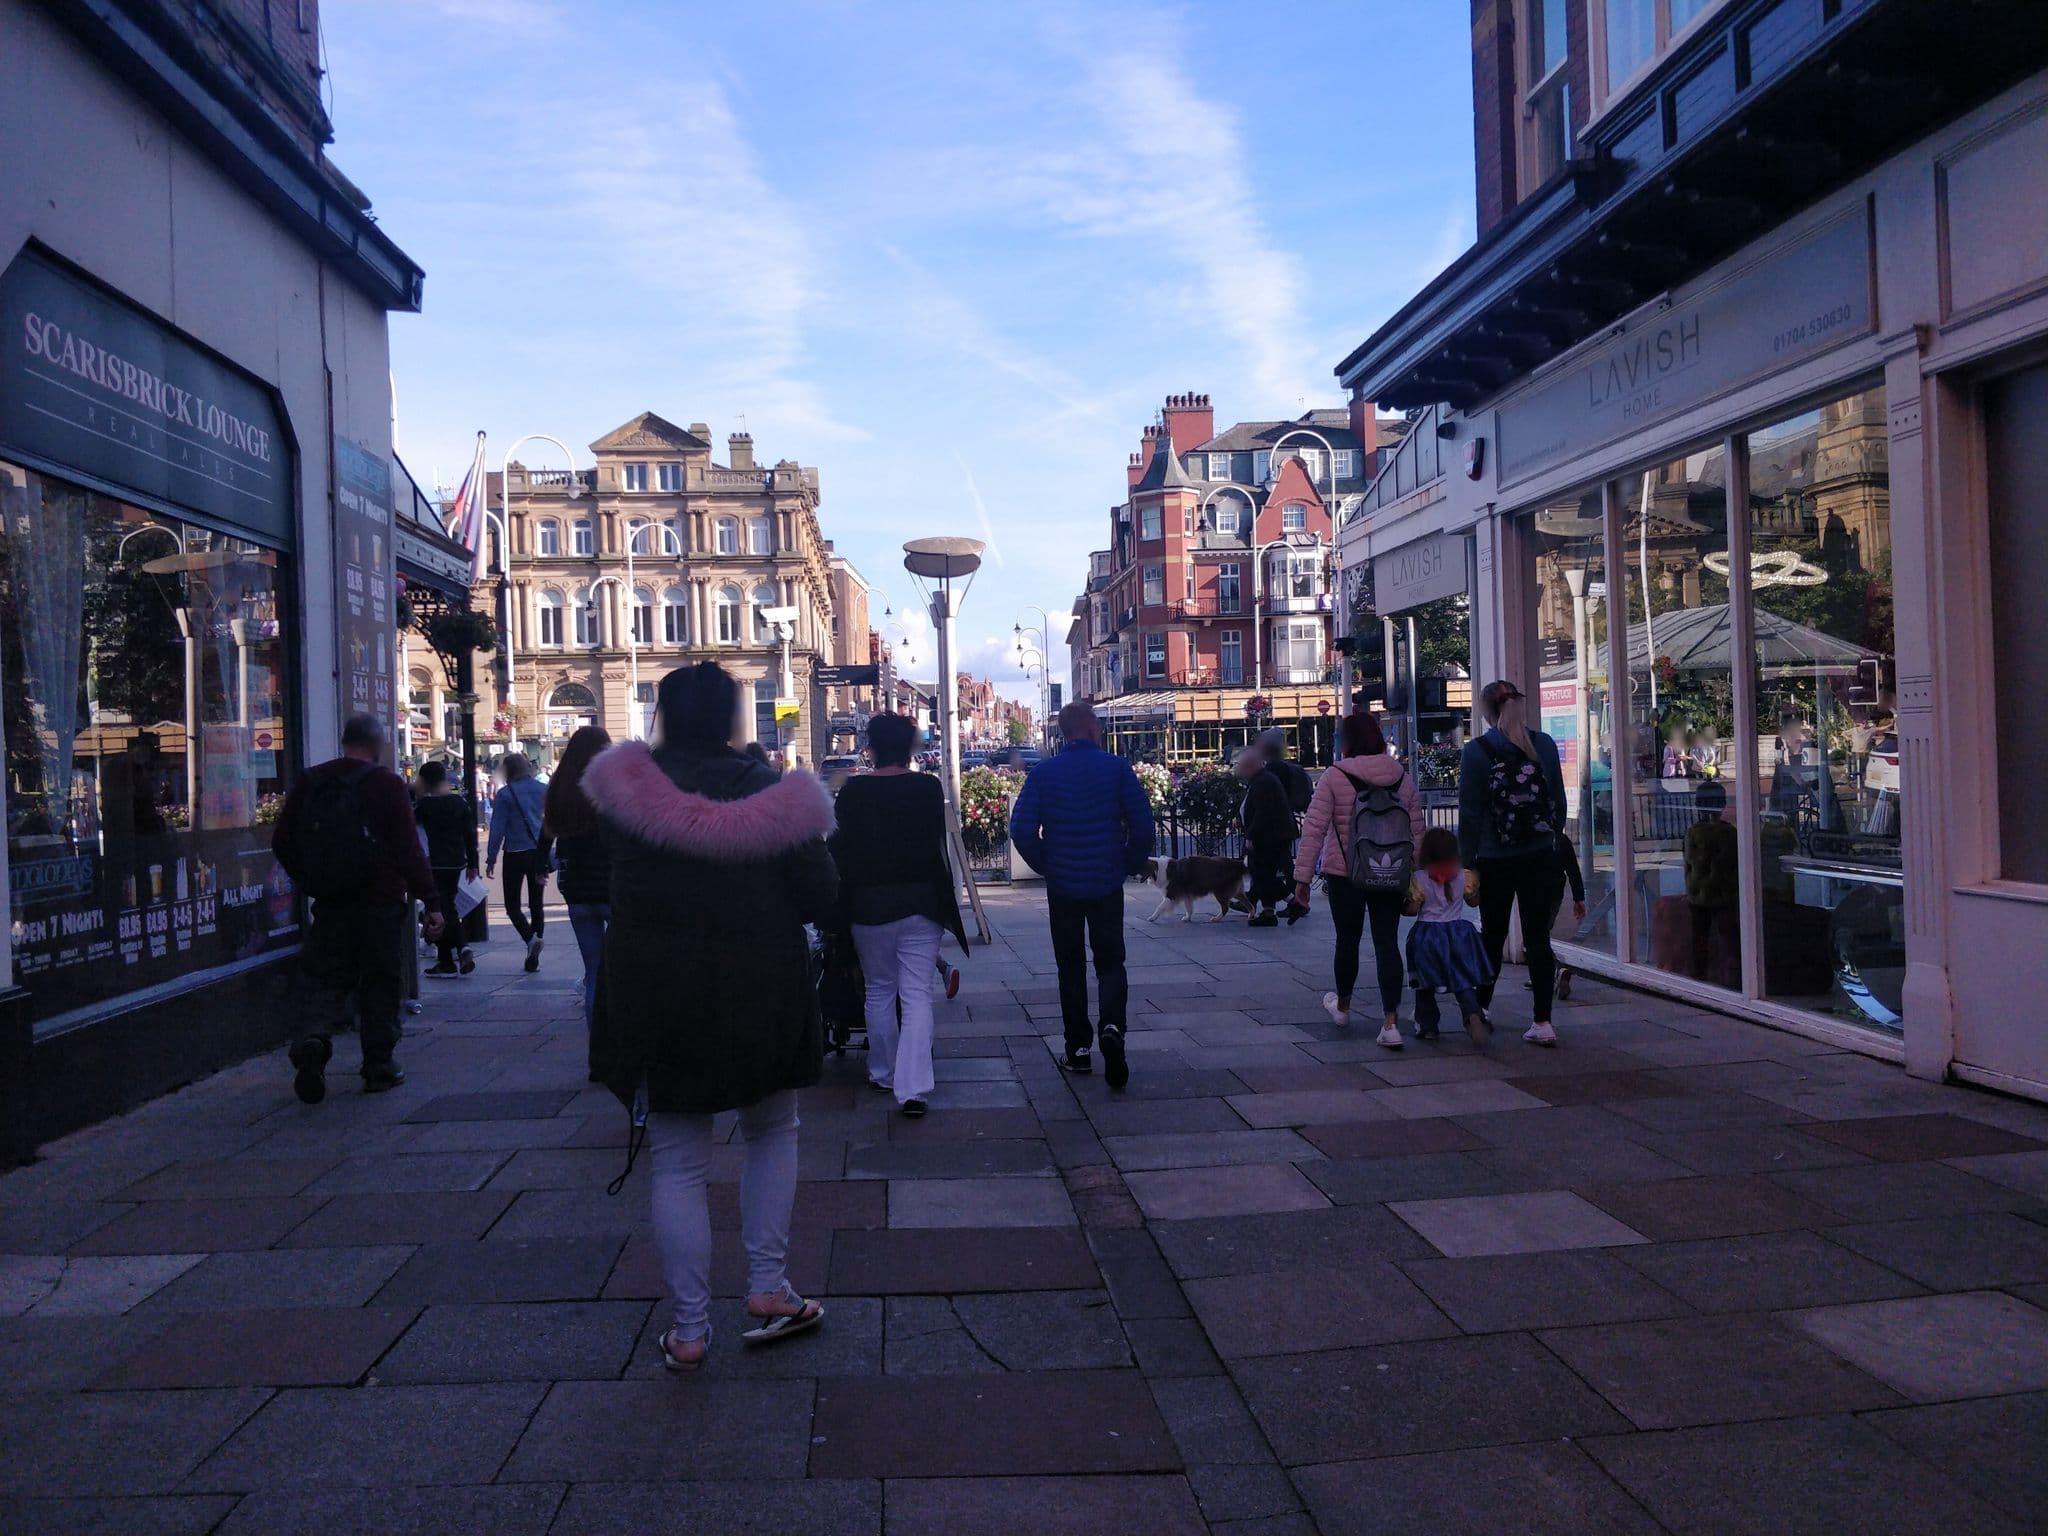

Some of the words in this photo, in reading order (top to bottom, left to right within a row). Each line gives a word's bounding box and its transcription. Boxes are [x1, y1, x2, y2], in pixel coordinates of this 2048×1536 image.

[1773, 325, 1806, 352] 01704
[1587, 313, 1701, 407] LAVISH
[24, 312, 193, 428] SCARISBRICK
[196, 398, 271, 463] LOUNGE
[1623, 388, 1662, 418] HOME
[88, 406, 155, 449] REAL
[181, 447, 235, 481] ALES
[1391, 543, 1442, 587] LAVISH
[223, 888, 239, 905] ALL
[1365, 877, 1400, 888] adidas
[11, 920, 47, 946] OPEN
[50, 914, 59, 938] 7
